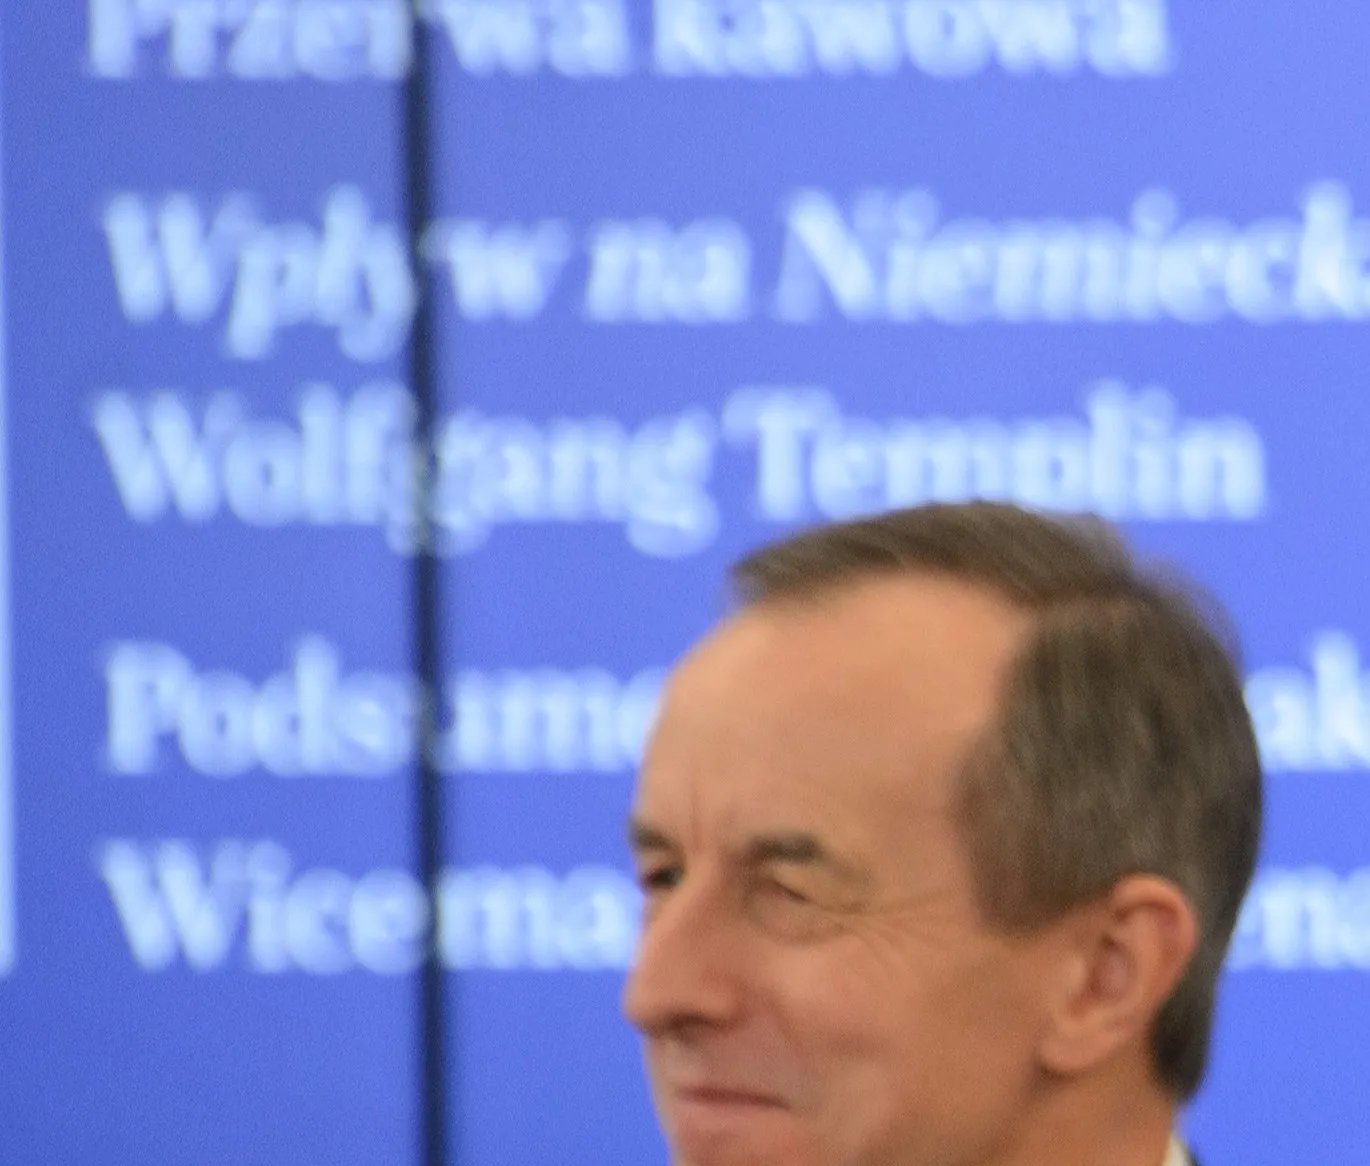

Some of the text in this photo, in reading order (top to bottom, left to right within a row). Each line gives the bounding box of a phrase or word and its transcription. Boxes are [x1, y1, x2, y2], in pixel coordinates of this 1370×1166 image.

[650, 0, 1172, 78] kawowa
[585, 220, 752, 324] na
[92, 382, 1268, 555] Wolfgang Templin
[95, 838, 646, 975] Wicema
